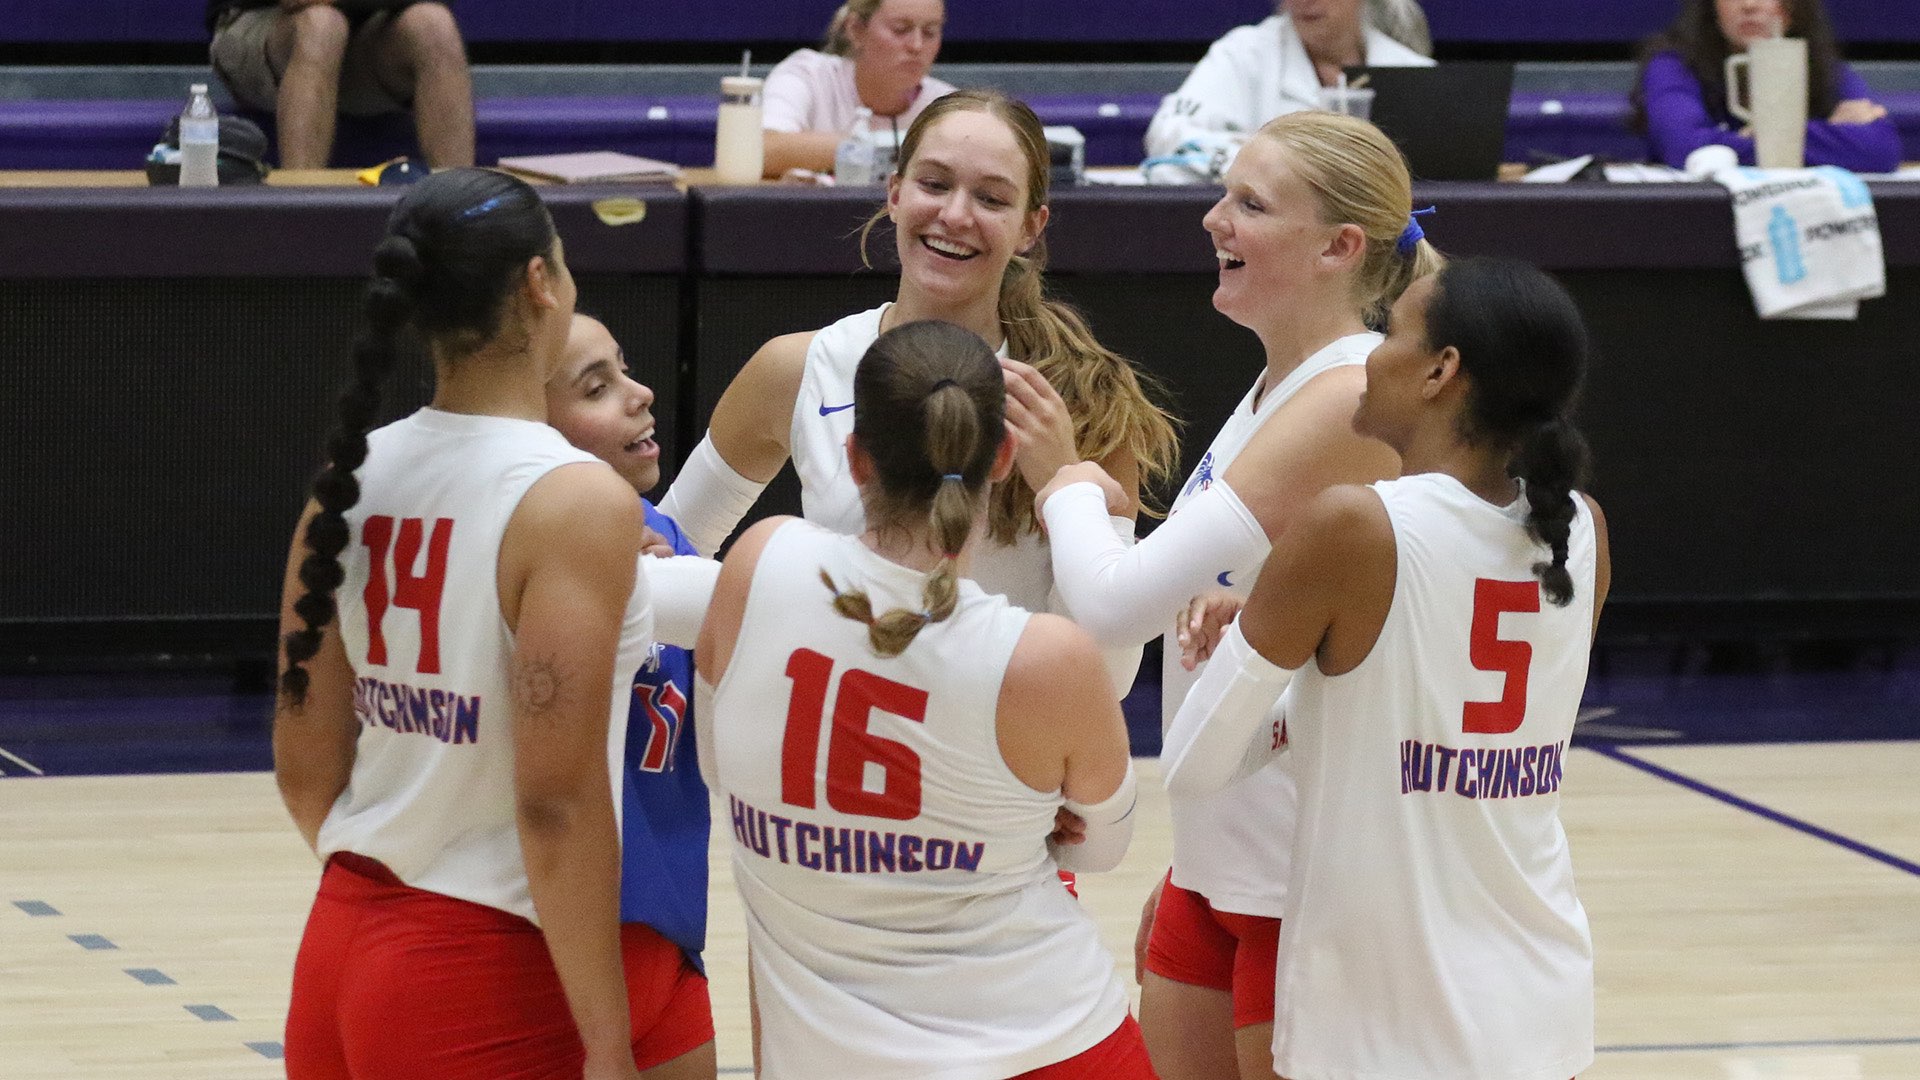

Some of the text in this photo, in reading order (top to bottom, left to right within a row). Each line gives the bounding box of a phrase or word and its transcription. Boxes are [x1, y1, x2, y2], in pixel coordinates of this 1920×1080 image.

[362, 515, 454, 674] 14
[1462, 578, 1540, 734] 5
[782, 646, 929, 820] 16
[1400, 739, 1564, 800] HUTCHINSON
[730, 793, 985, 873] HUTCHINSON
